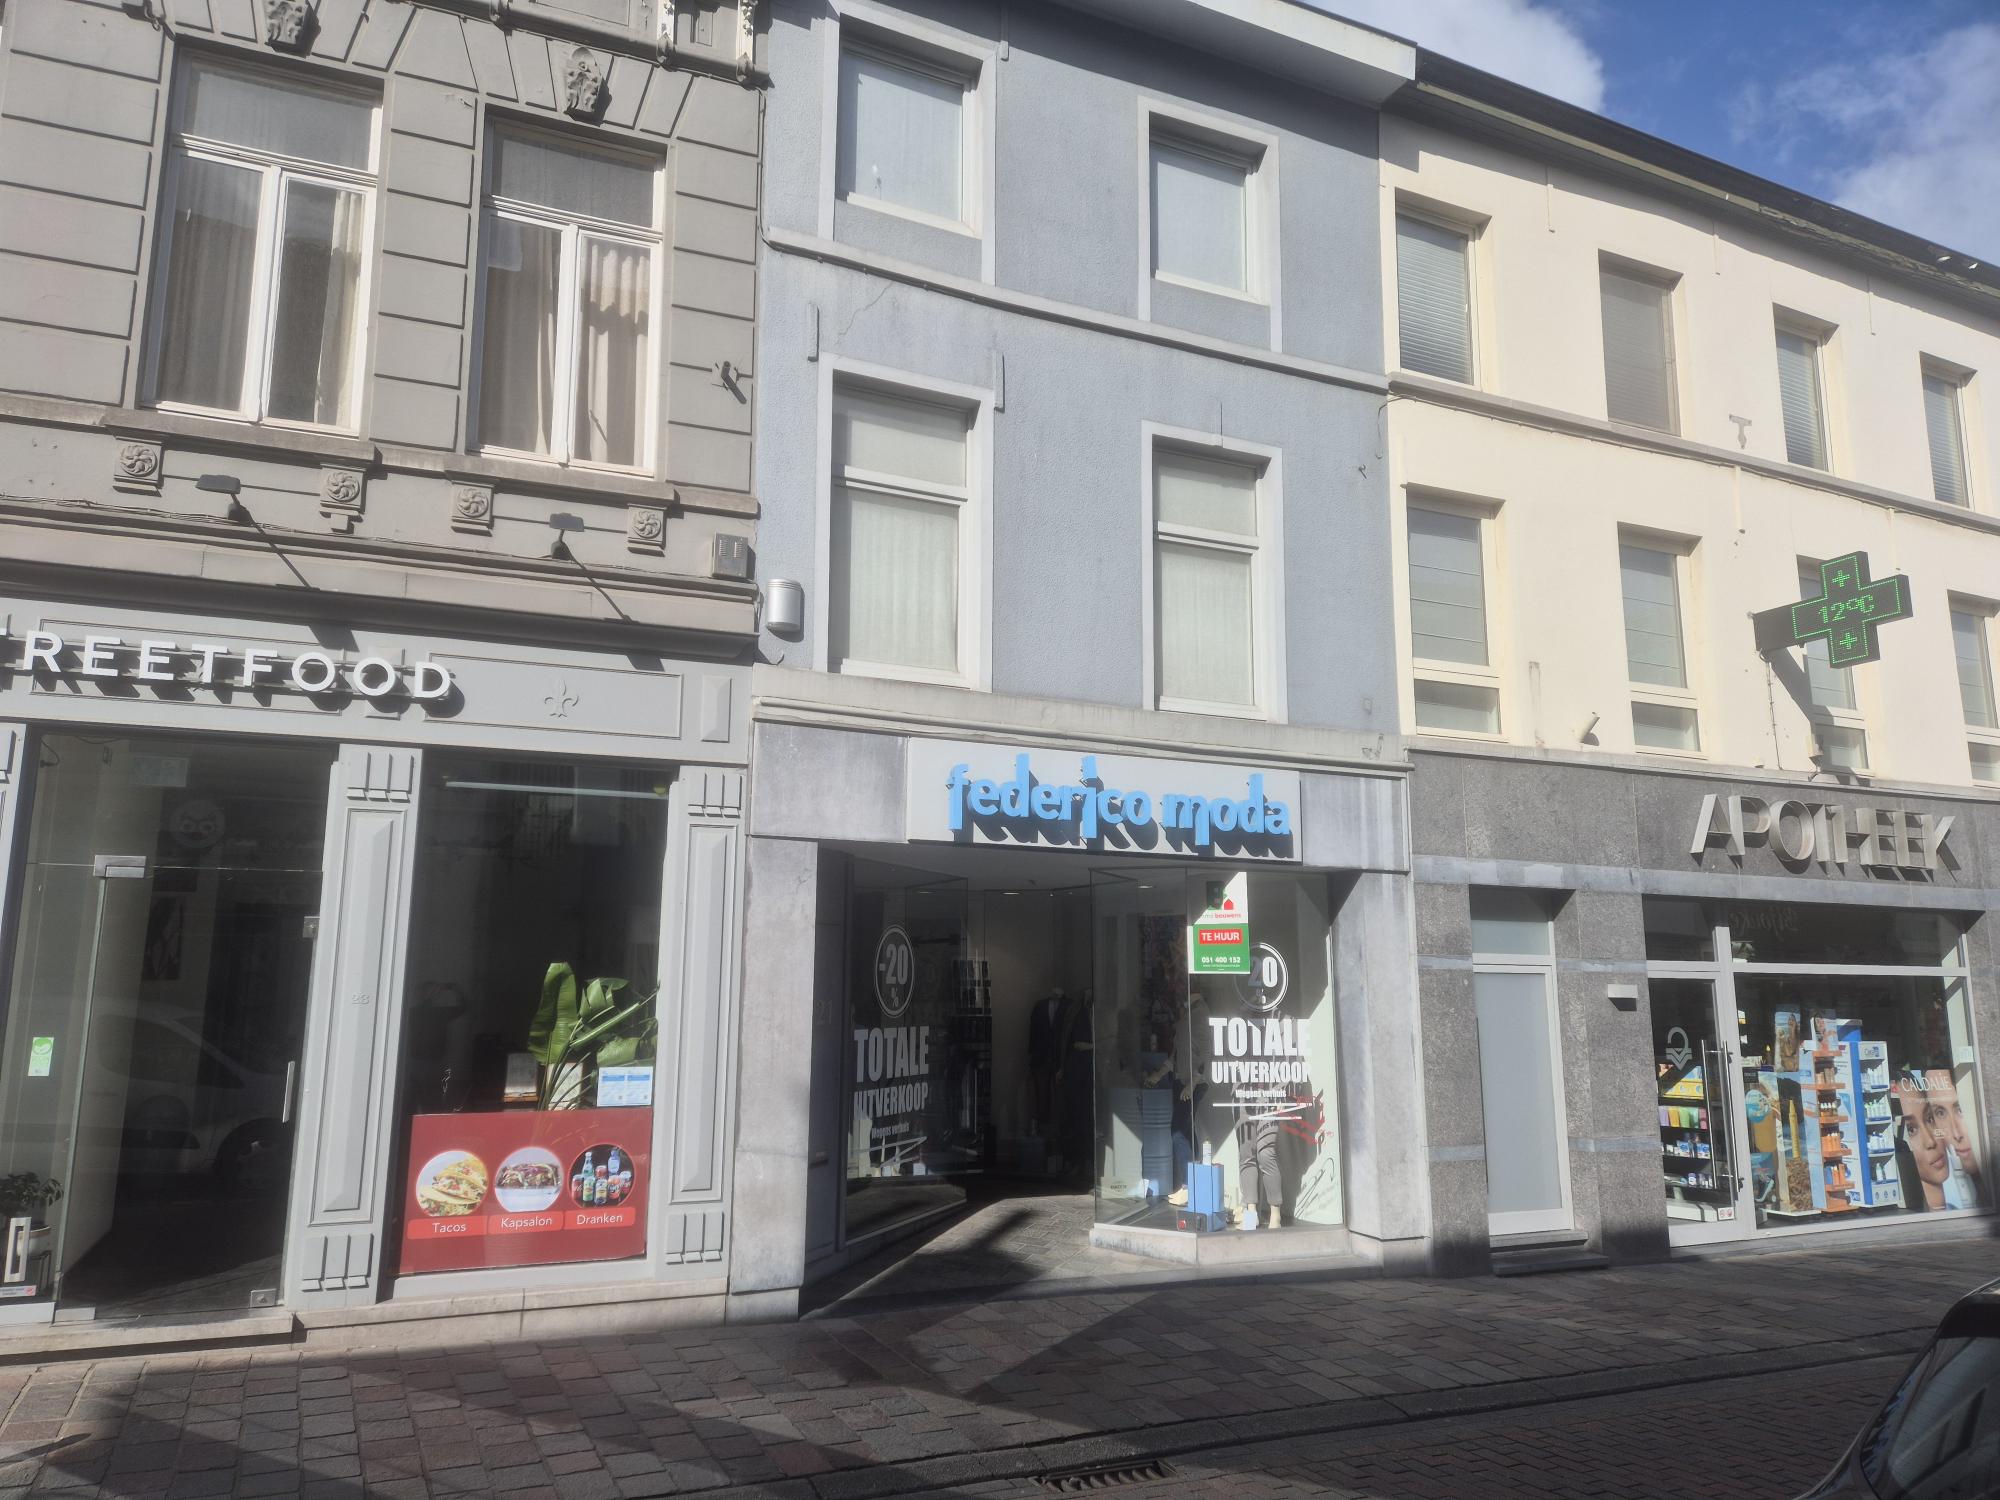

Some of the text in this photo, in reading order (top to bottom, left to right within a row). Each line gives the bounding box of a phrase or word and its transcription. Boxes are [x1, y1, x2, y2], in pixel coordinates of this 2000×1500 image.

[0, 627, 451, 698] REETFOOD
[946, 753, 1290, 846] federico moda
[1690, 794, 1957, 870] APOTHEEK
[1201, 932, 1241, 942] TE HUUR
[879, 943, 909, 985] -20
[1248, 956, 1278, 988] 20
[854, 1026, 930, 1083] TOTALE
[1208, 1017, 1312, 1057] TOTALE
[1211, 1060, 1312, 1085] UITVERKOOP
[854, 1082, 929, 1121] UITVERKOOP
[432, 1222, 467, 1233] Tacos
[501, 1215, 553, 1230] Kapsalon
[577, 1214, 623, 1225] Dranken
